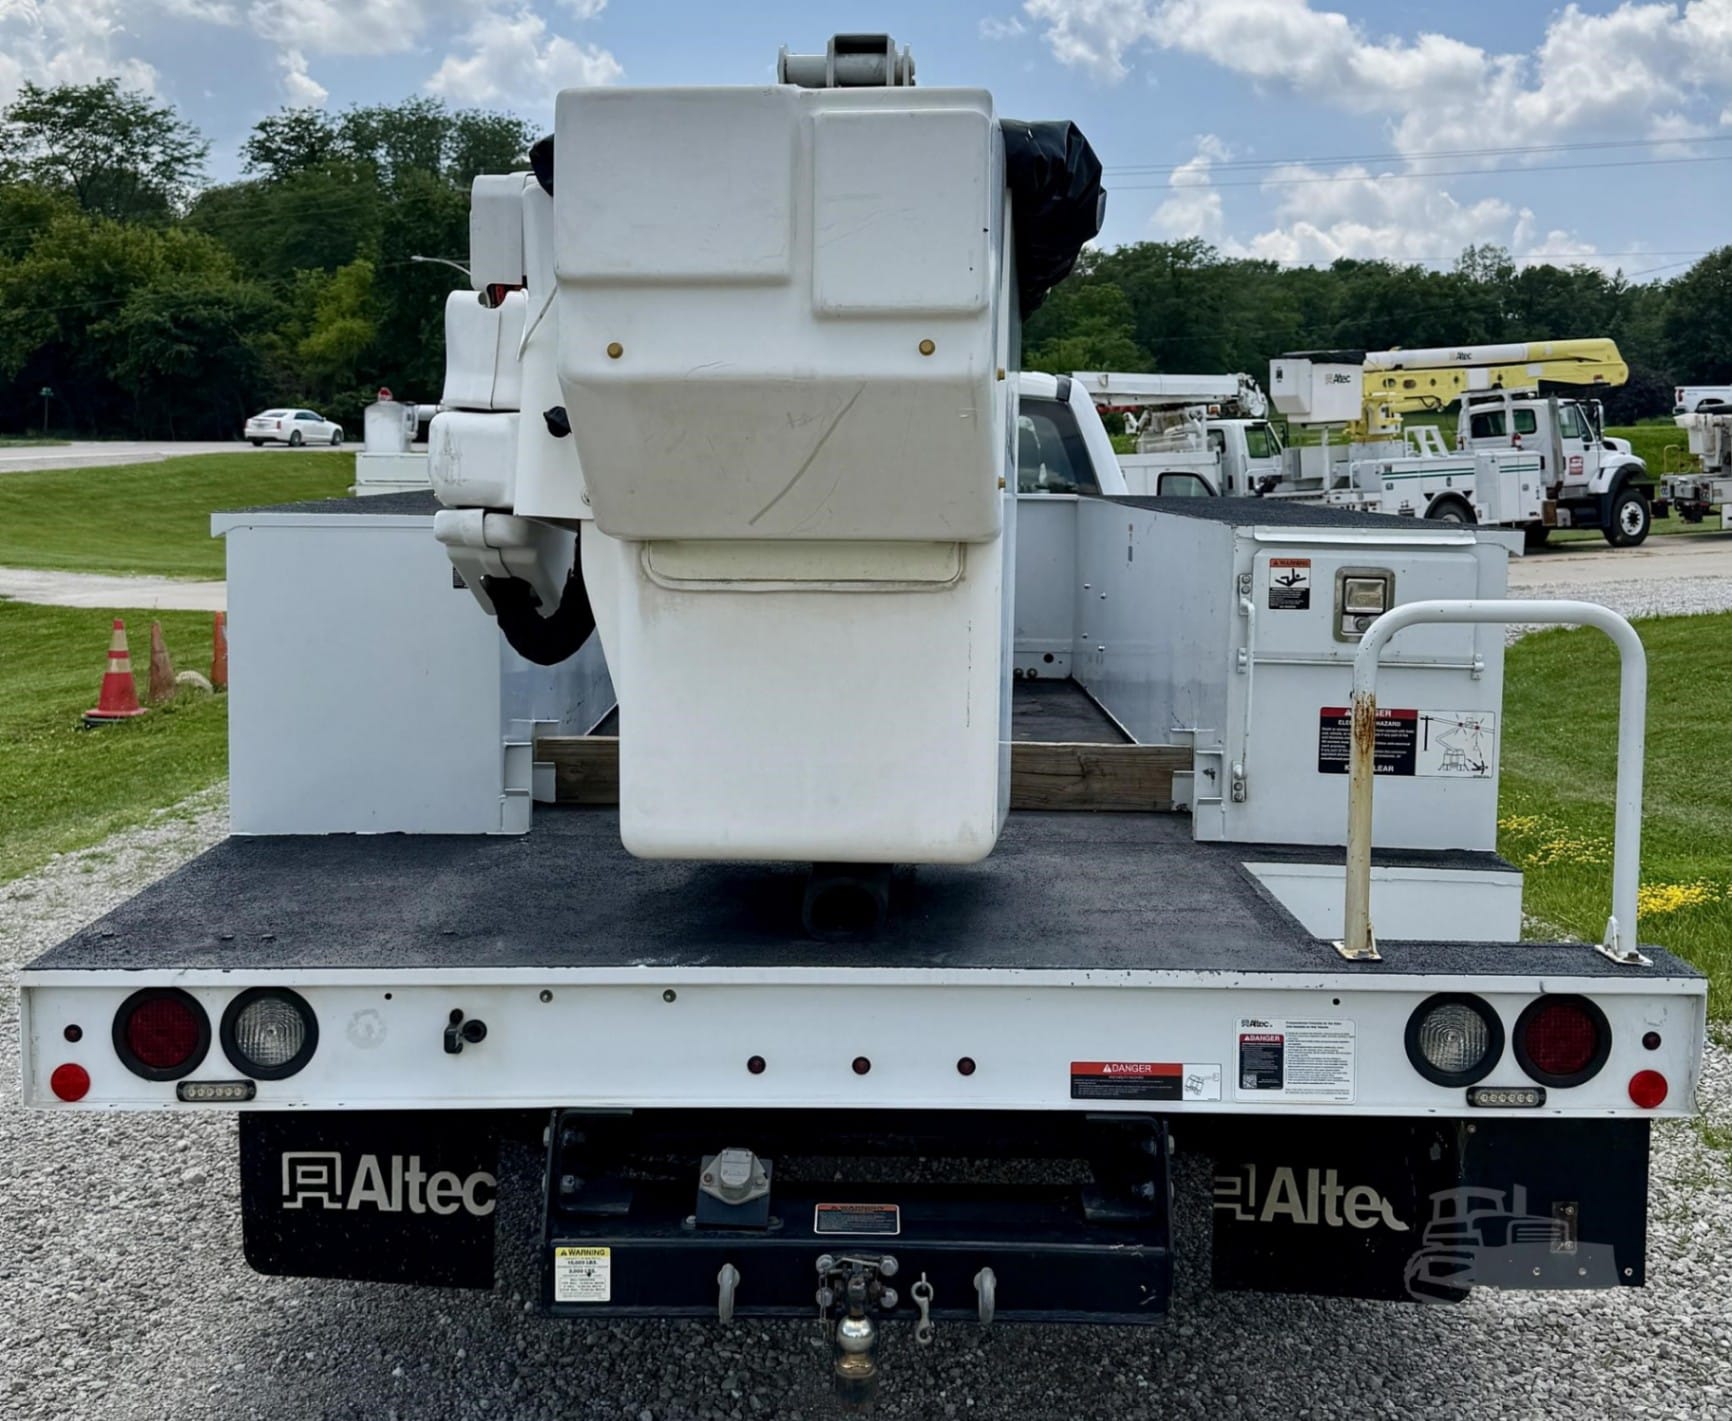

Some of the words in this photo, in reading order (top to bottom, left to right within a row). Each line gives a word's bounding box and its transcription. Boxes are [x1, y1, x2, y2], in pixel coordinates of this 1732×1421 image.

[1332, 373, 1351, 384] Altec
[1373, 764, 1395, 773] LEAR
[1249, 1034, 1281, 1042] DANGER
[1111, 1063, 1152, 1074] DANGER
[346, 1153, 498, 1216] Altec
